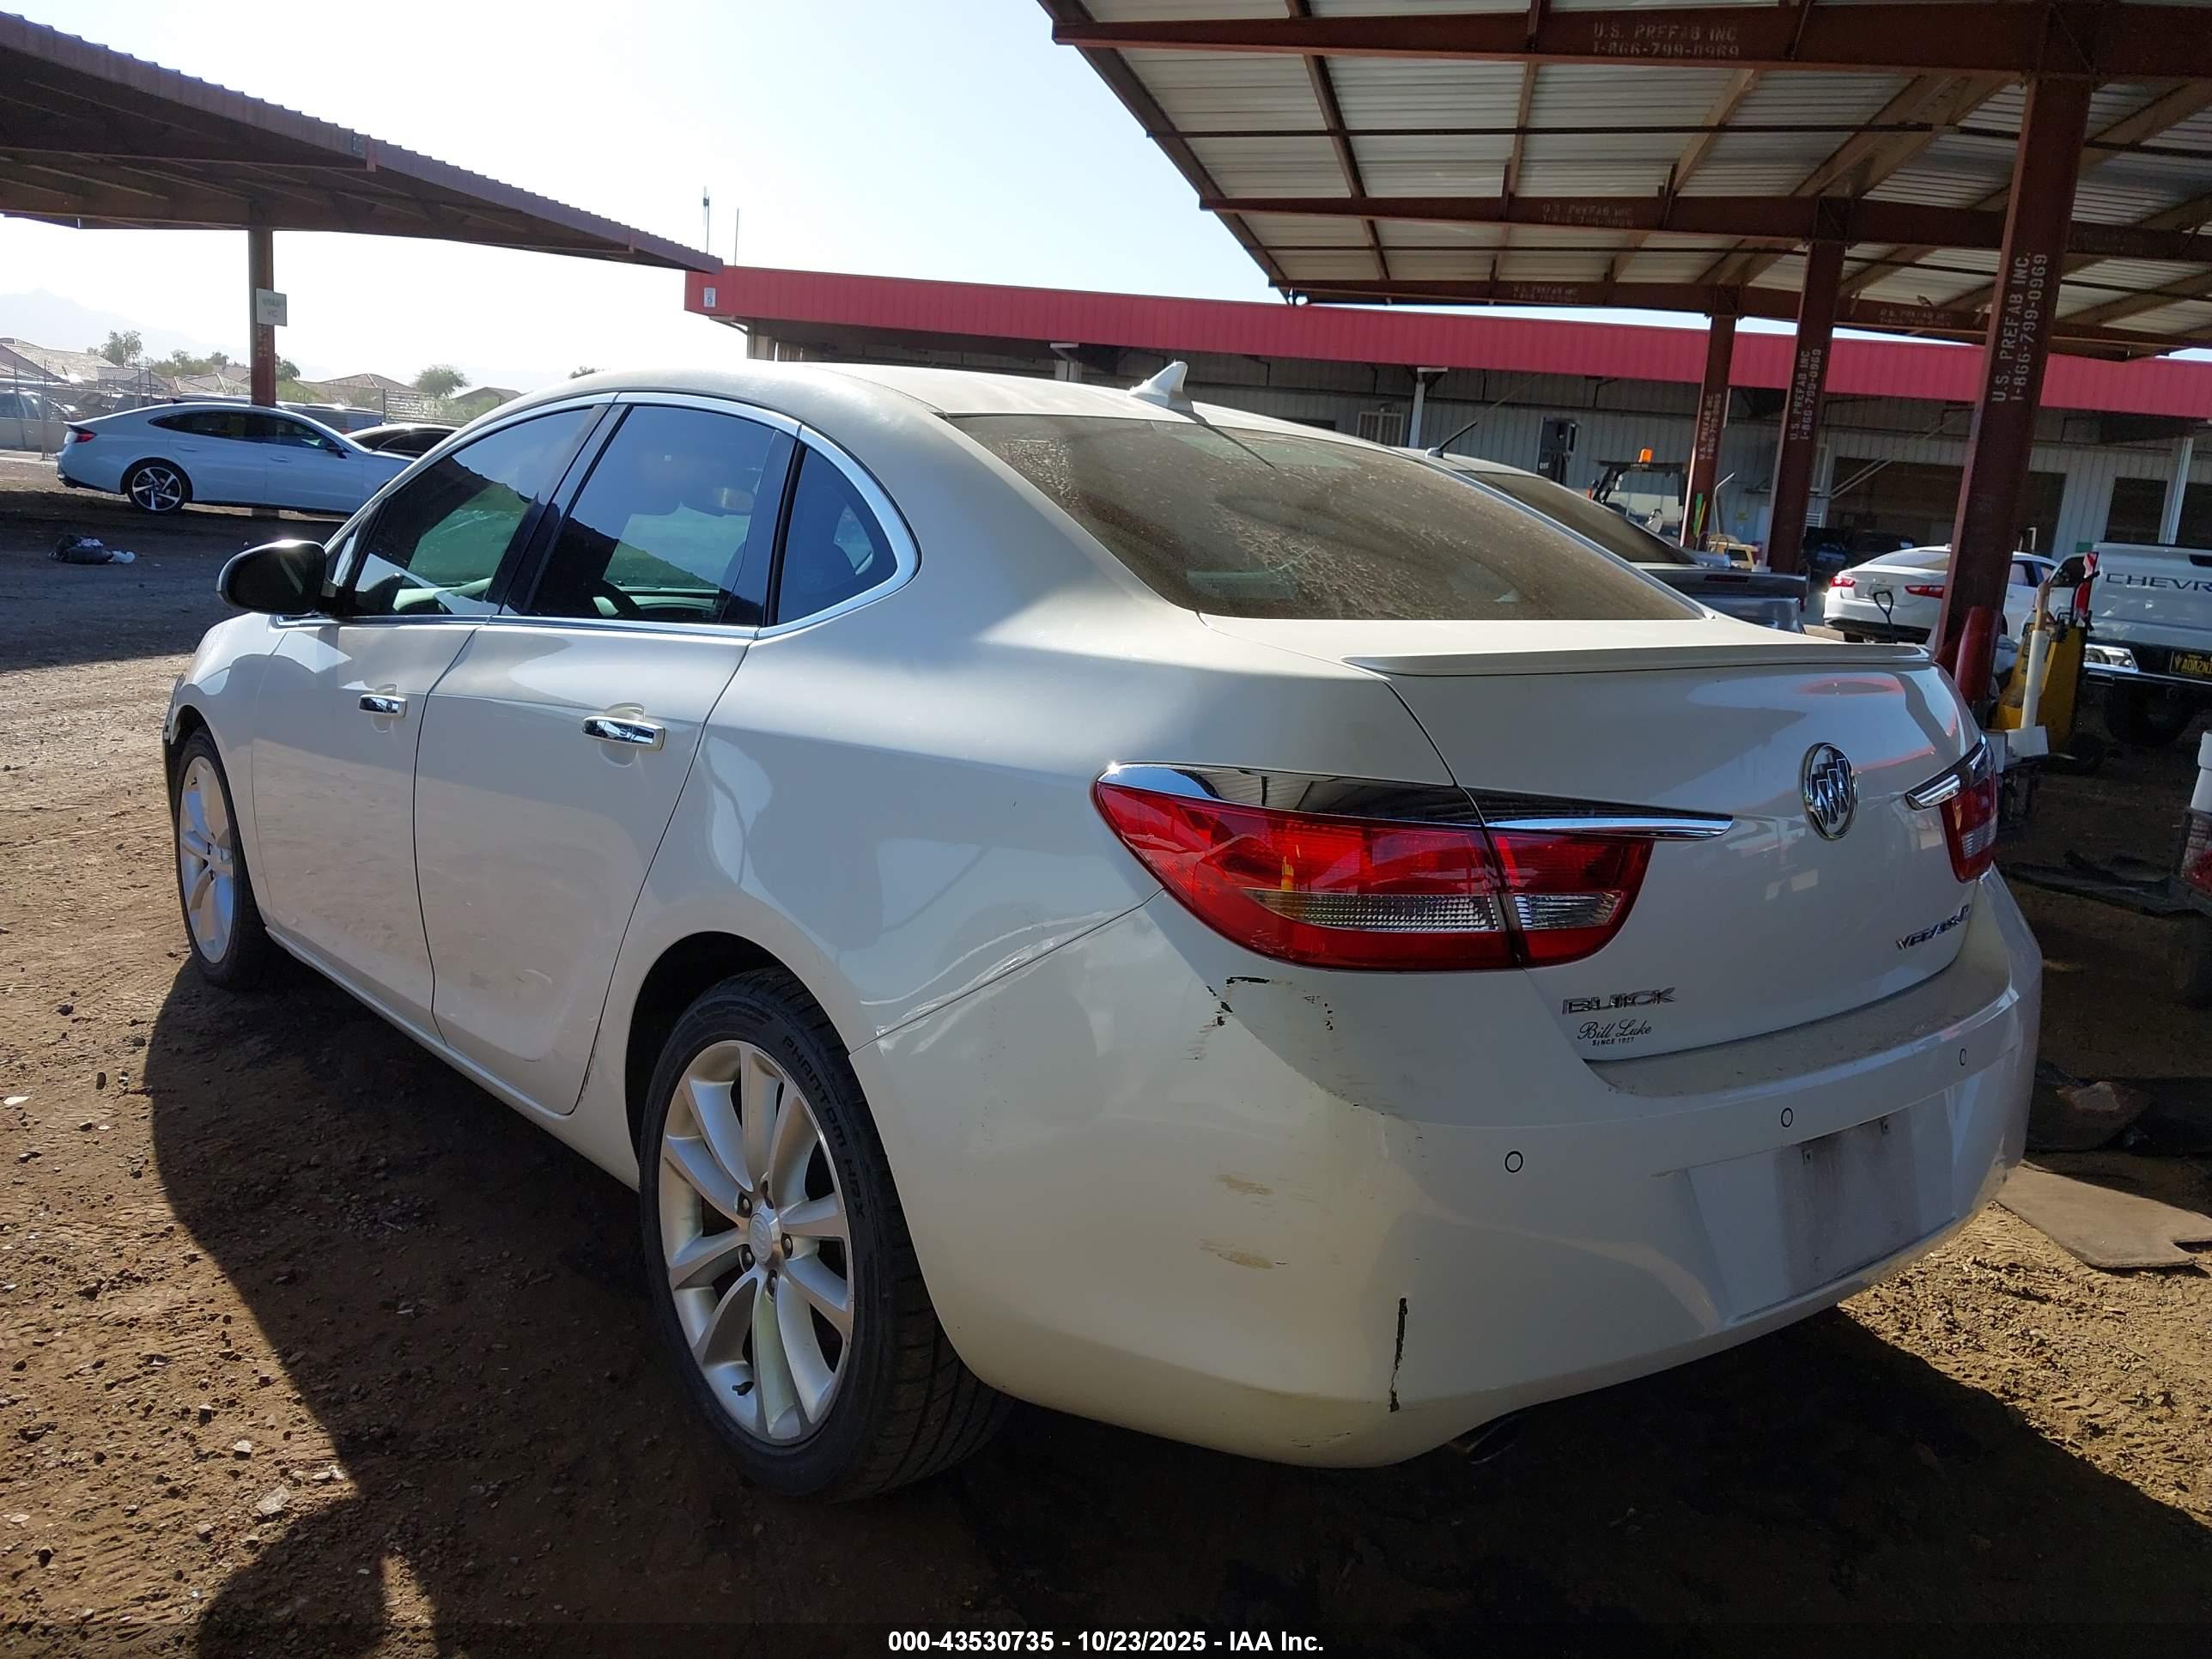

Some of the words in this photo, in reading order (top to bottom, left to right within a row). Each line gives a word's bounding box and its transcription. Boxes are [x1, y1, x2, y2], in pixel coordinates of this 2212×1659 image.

[2011, 252, 2031, 284] INC.
[1999, 294, 2023, 360] PREFAB
[2010, 253, 2048, 401] 1-866-799-0969
[1991, 369, 2011, 402] U.S.
[1561, 987, 1676, 1015] BUICK
[1577, 1021, 1616, 1040] Bill
[1616, 1018, 1652, 1037] Luke
[782, 1035, 848, 1148] PHANTOM
